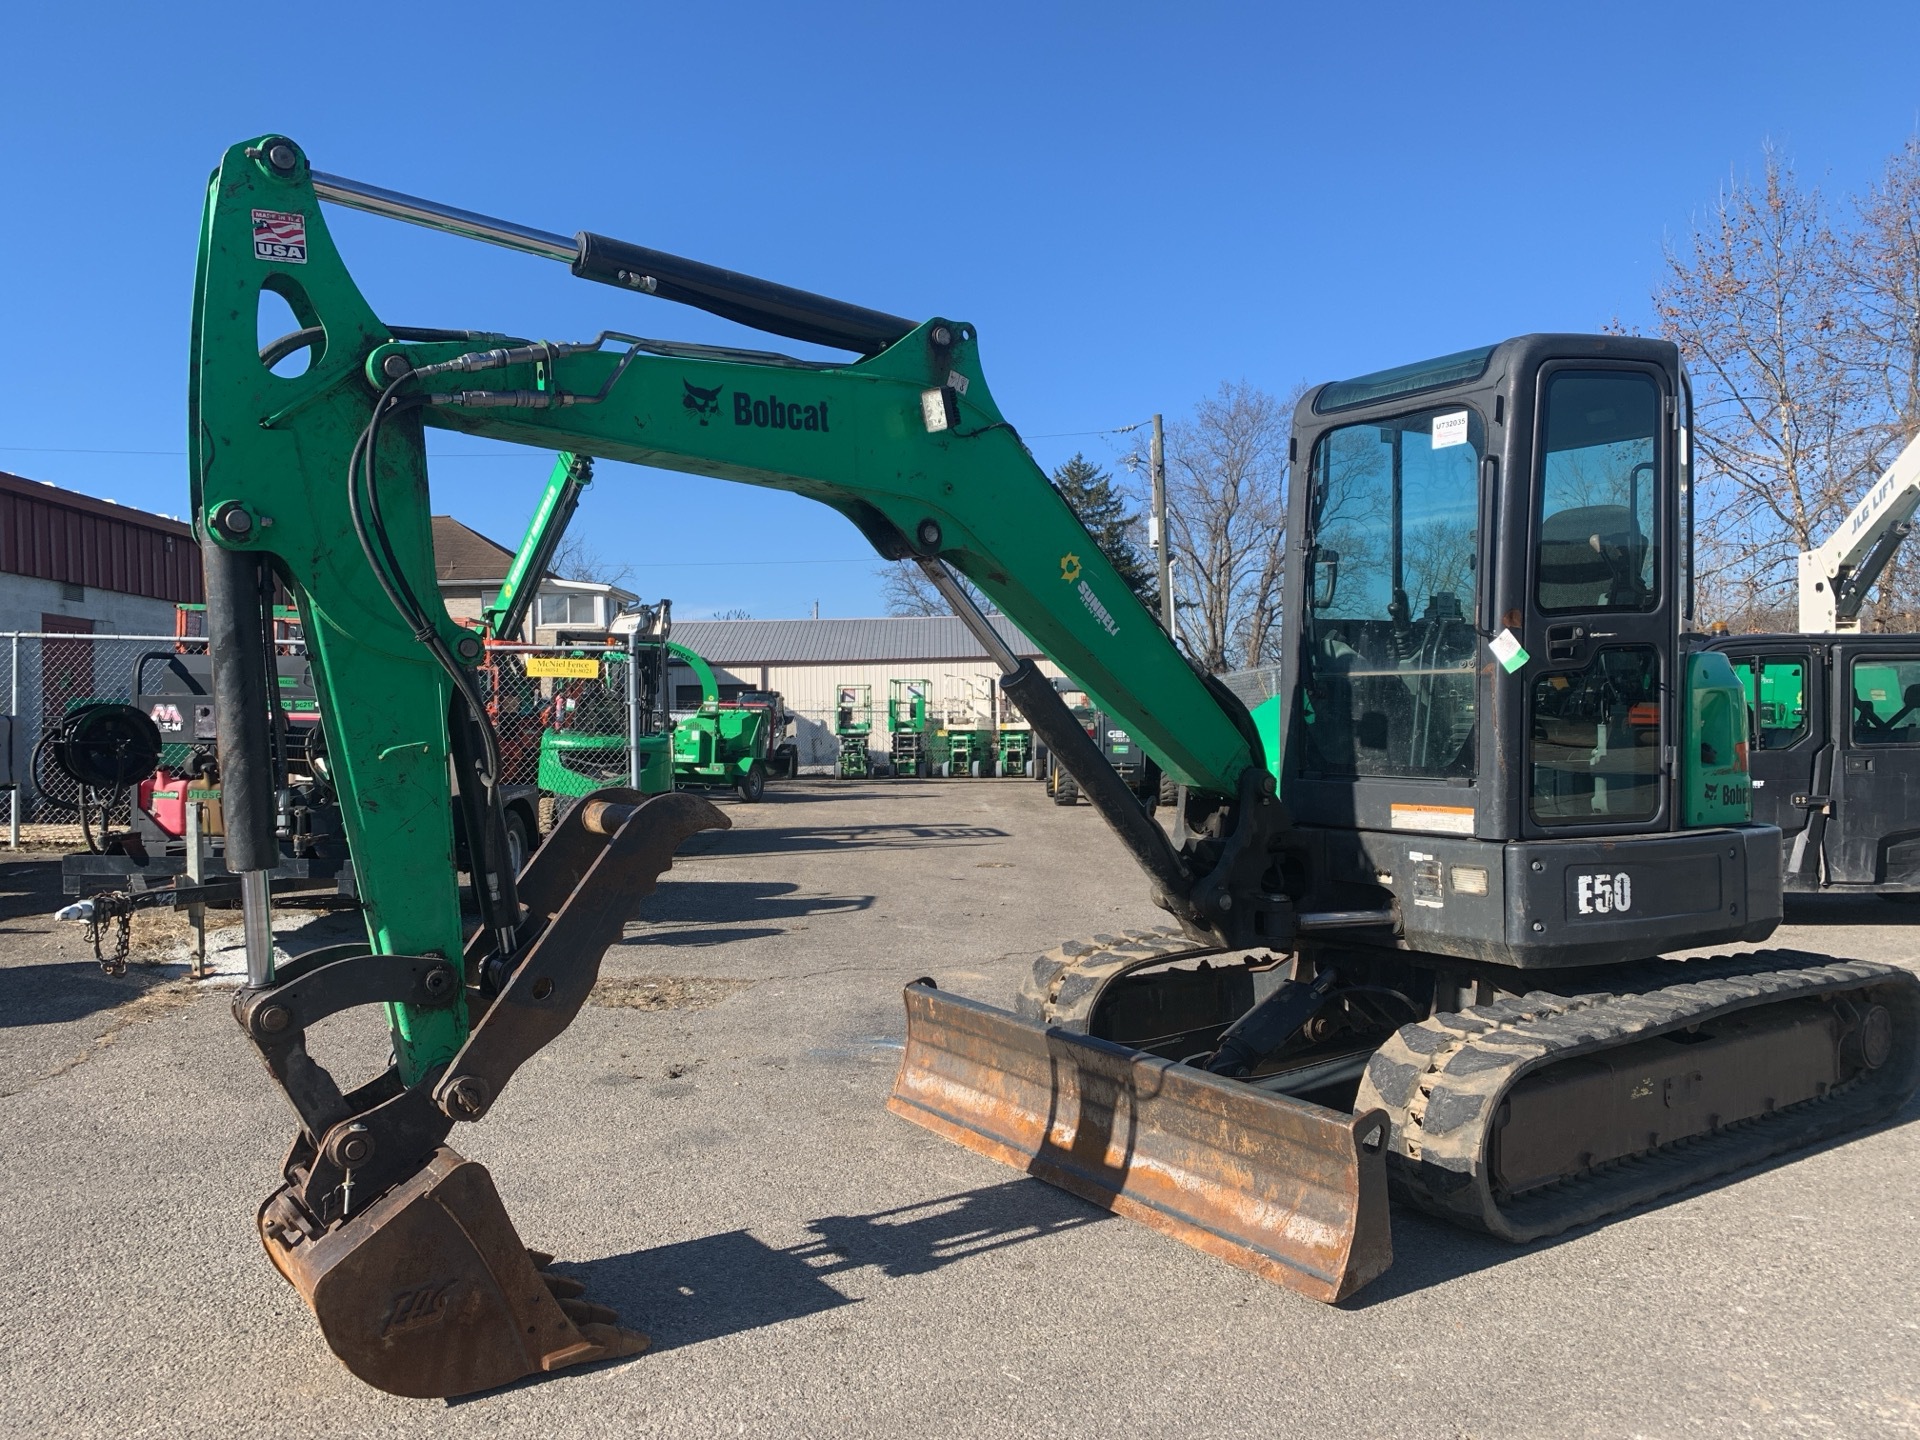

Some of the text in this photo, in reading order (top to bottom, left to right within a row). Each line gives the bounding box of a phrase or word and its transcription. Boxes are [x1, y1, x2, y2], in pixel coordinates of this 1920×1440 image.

[257, 243, 303, 259] USA
[733, 391, 830, 433] Bobcat
[1436, 418, 1466, 429] U732035
[1851, 474, 1896, 535] JLG LIFT
[666, 643, 695, 663] ermeer
[537, 660, 590, 669] McNiel Fence
[188, 789, 222, 799] Diese
[1578, 872, 1632, 915] E50
